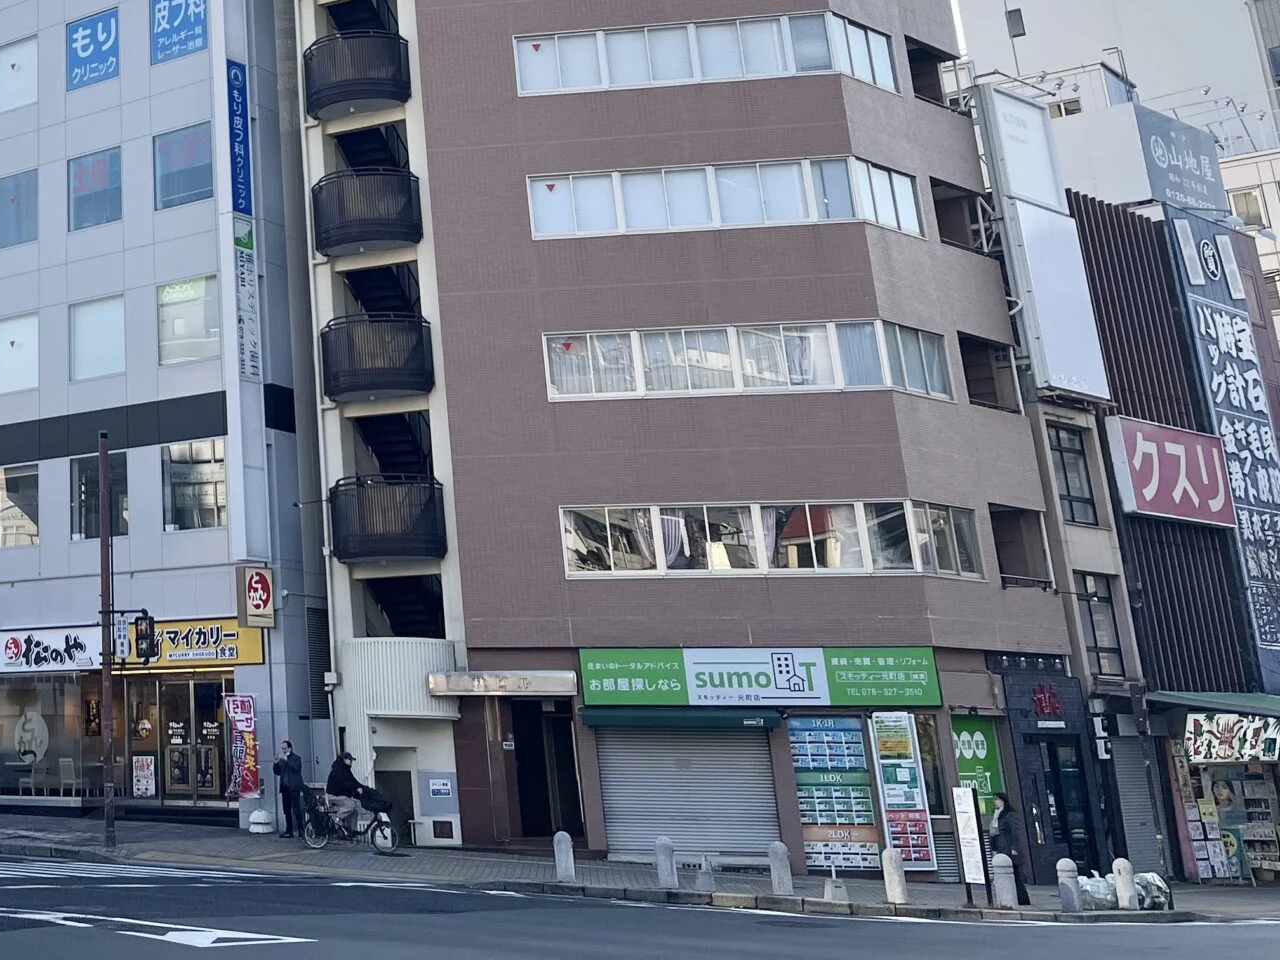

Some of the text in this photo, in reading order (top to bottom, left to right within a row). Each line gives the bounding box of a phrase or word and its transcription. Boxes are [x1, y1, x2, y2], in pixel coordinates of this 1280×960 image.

[72, 17, 117, 58] もり
[72, 56, 117, 84] クリニック
[232, 89, 246, 209] もり皮フ科クリニック
[1133, 432, 1228, 514] クスリ
[165, 625, 239, 648] マイカリー
[22, 633, 87, 668] 松のや
[219, 645, 238, 658] 食堂
[587, 662, 680, 671] 住まいのトータルアドバイス
[694, 661, 817, 692] sumo T
[589, 677, 681, 691] お部屋探しなら
[846, 687, 923, 696] TEL 078-327-3510
[820, 773, 843, 783] 1LDK
